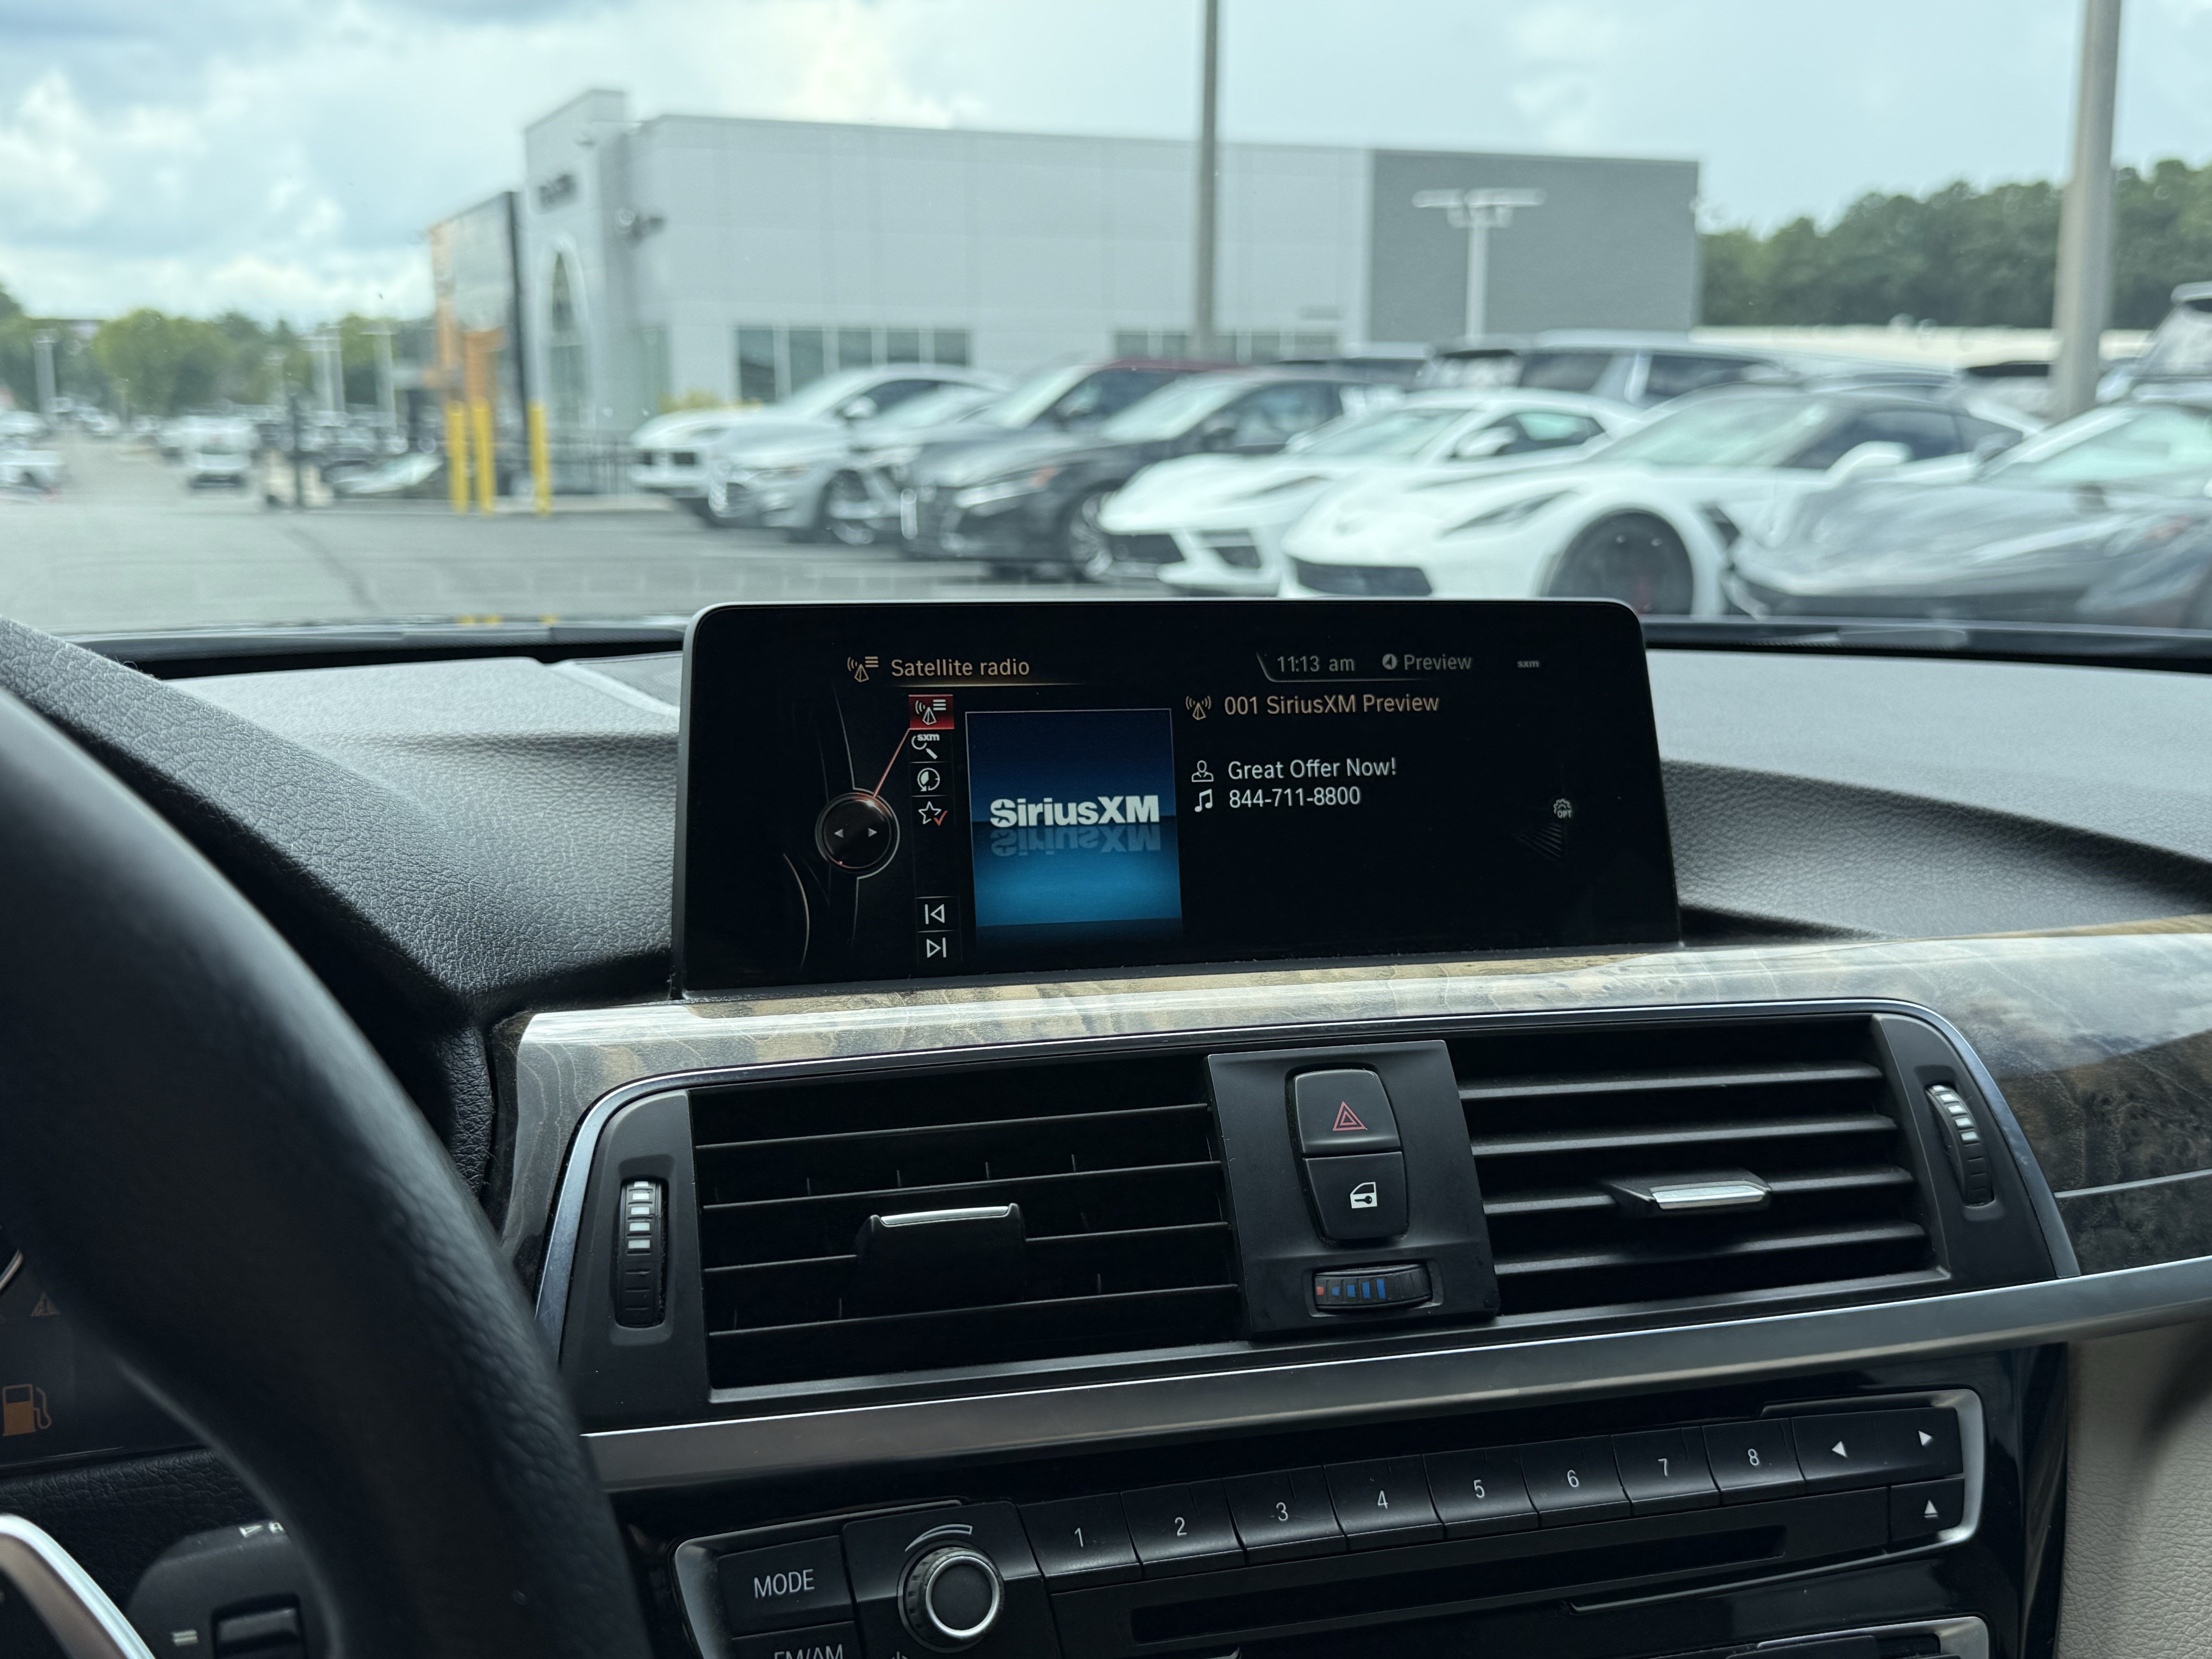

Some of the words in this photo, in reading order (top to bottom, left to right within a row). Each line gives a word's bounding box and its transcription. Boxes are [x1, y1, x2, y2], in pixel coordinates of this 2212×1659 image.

[891, 658, 973, 677] Satellite
[980, 658, 1029, 675] radio
[1277, 655, 1320, 672] 11:13
[1329, 658, 1355, 672] am
[1404, 654, 1472, 671] Preview
[1517, 660, 1539, 668] sxm
[1224, 696, 1258, 715] 001
[1266, 694, 1356, 714] SiriusXM
[1363, 693, 1439, 712] Preview
[1228, 761, 1283, 780] Great
[1290, 758, 1340, 778] Offer
[1346, 757, 1396, 776] Now!
[1229, 786, 1360, 808] 844-711-8800
[990, 795, 1159, 828] SiriusXM
[1557, 810, 1572, 818] OPT
[1074, 1527, 1084, 1547] 1
[1175, 1517, 1187, 1537] 2
[1276, 1502, 1289, 1522] 3
[1377, 1490, 1388, 1509] 4
[1473, 1479, 1486, 1499] 5
[1567, 1470, 1580, 1488] 6
[1658, 1458, 1668, 1476] 7
[1747, 1448, 1760, 1467] 8
[754, 1568, 815, 1599] MODE
